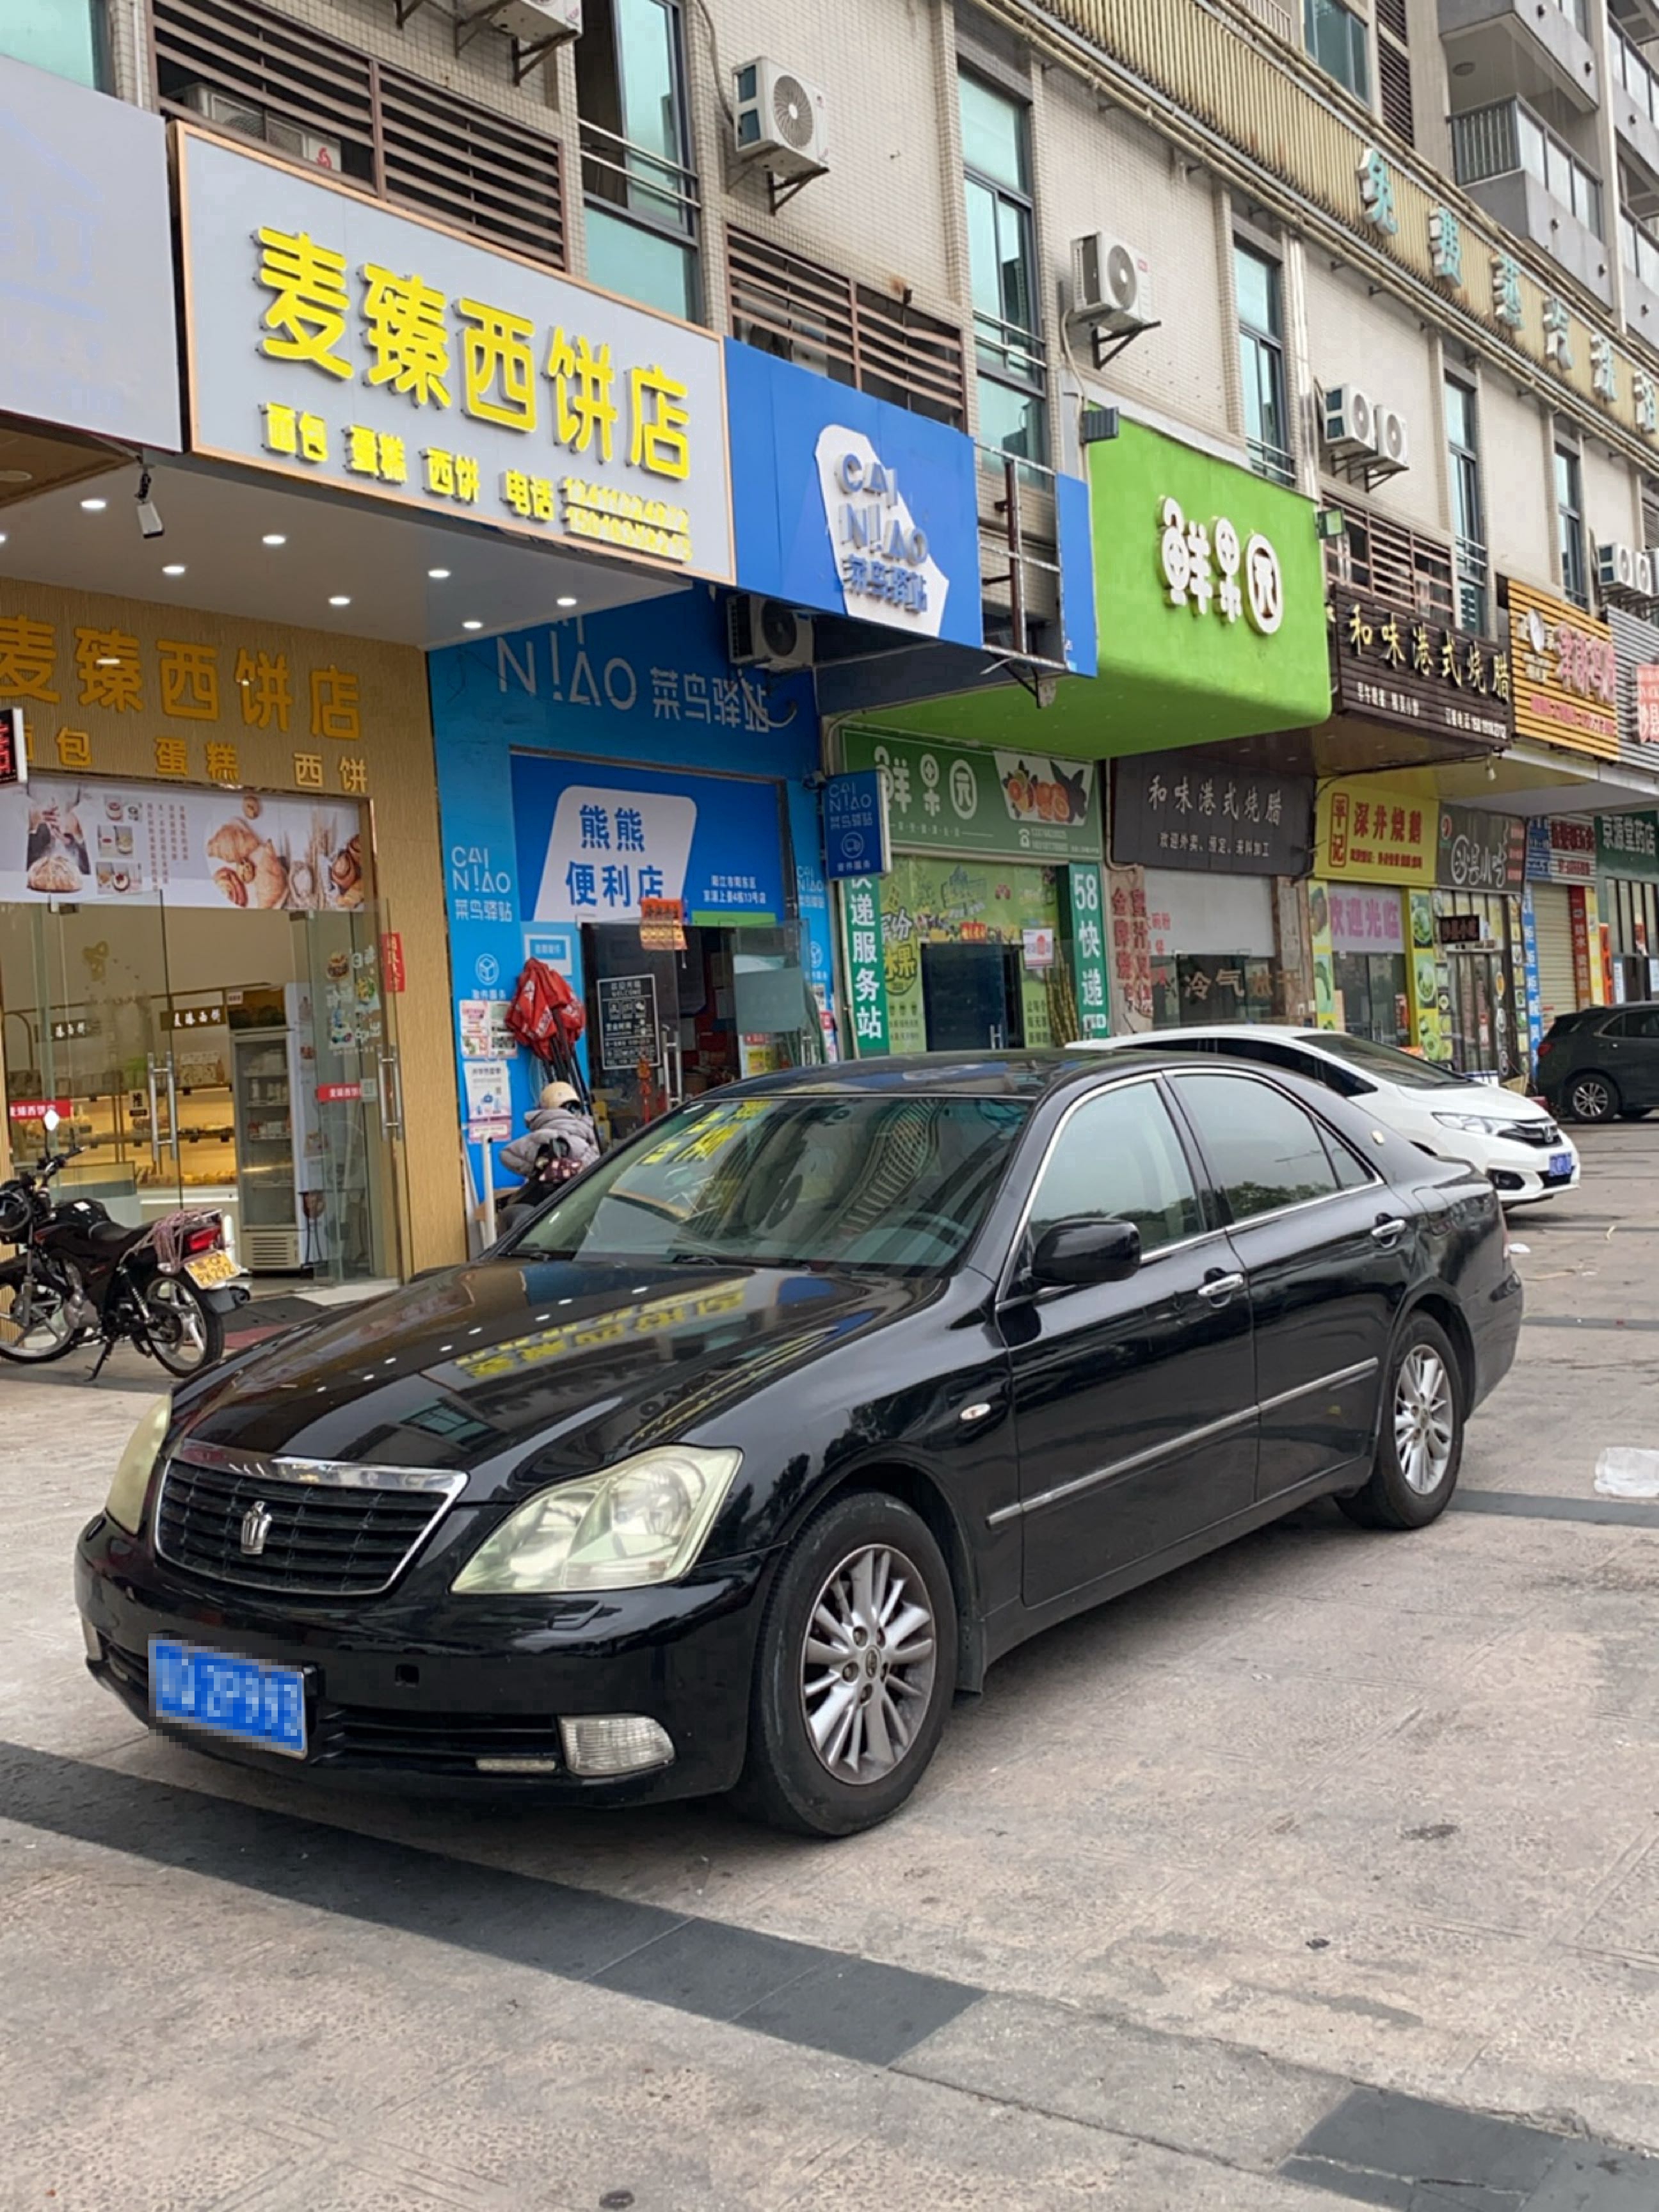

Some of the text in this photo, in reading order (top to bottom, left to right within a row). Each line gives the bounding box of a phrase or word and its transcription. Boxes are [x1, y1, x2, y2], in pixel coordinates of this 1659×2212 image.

[252, 227, 690, 480] 麦臻西饼店
[260, 403, 554, 521] 面包 蛋糕 西饼 电话
[843, 554, 928, 615] 菜鸟驿站
[0, 614, 361, 740] 麦臻西饼店
[1349, 604, 1511, 702] 和味港式烧腊
[650, 667, 769, 733] 菜鸟驿站
[155, 736, 239, 782] 蛋糕
[293, 751, 367, 794] 西饼
[1148, 775, 1282, 826] 和味港式烧腊
[579, 804, 646, 852] 熊熊
[451, 846, 488, 870] CAI
[566, 861, 664, 906] 便利店
[455, 898, 512, 922] 菜鸟驿站
[1329, 897, 1400, 940] 欢迎光临
[1185, 968, 1244, 1000] 冷气
